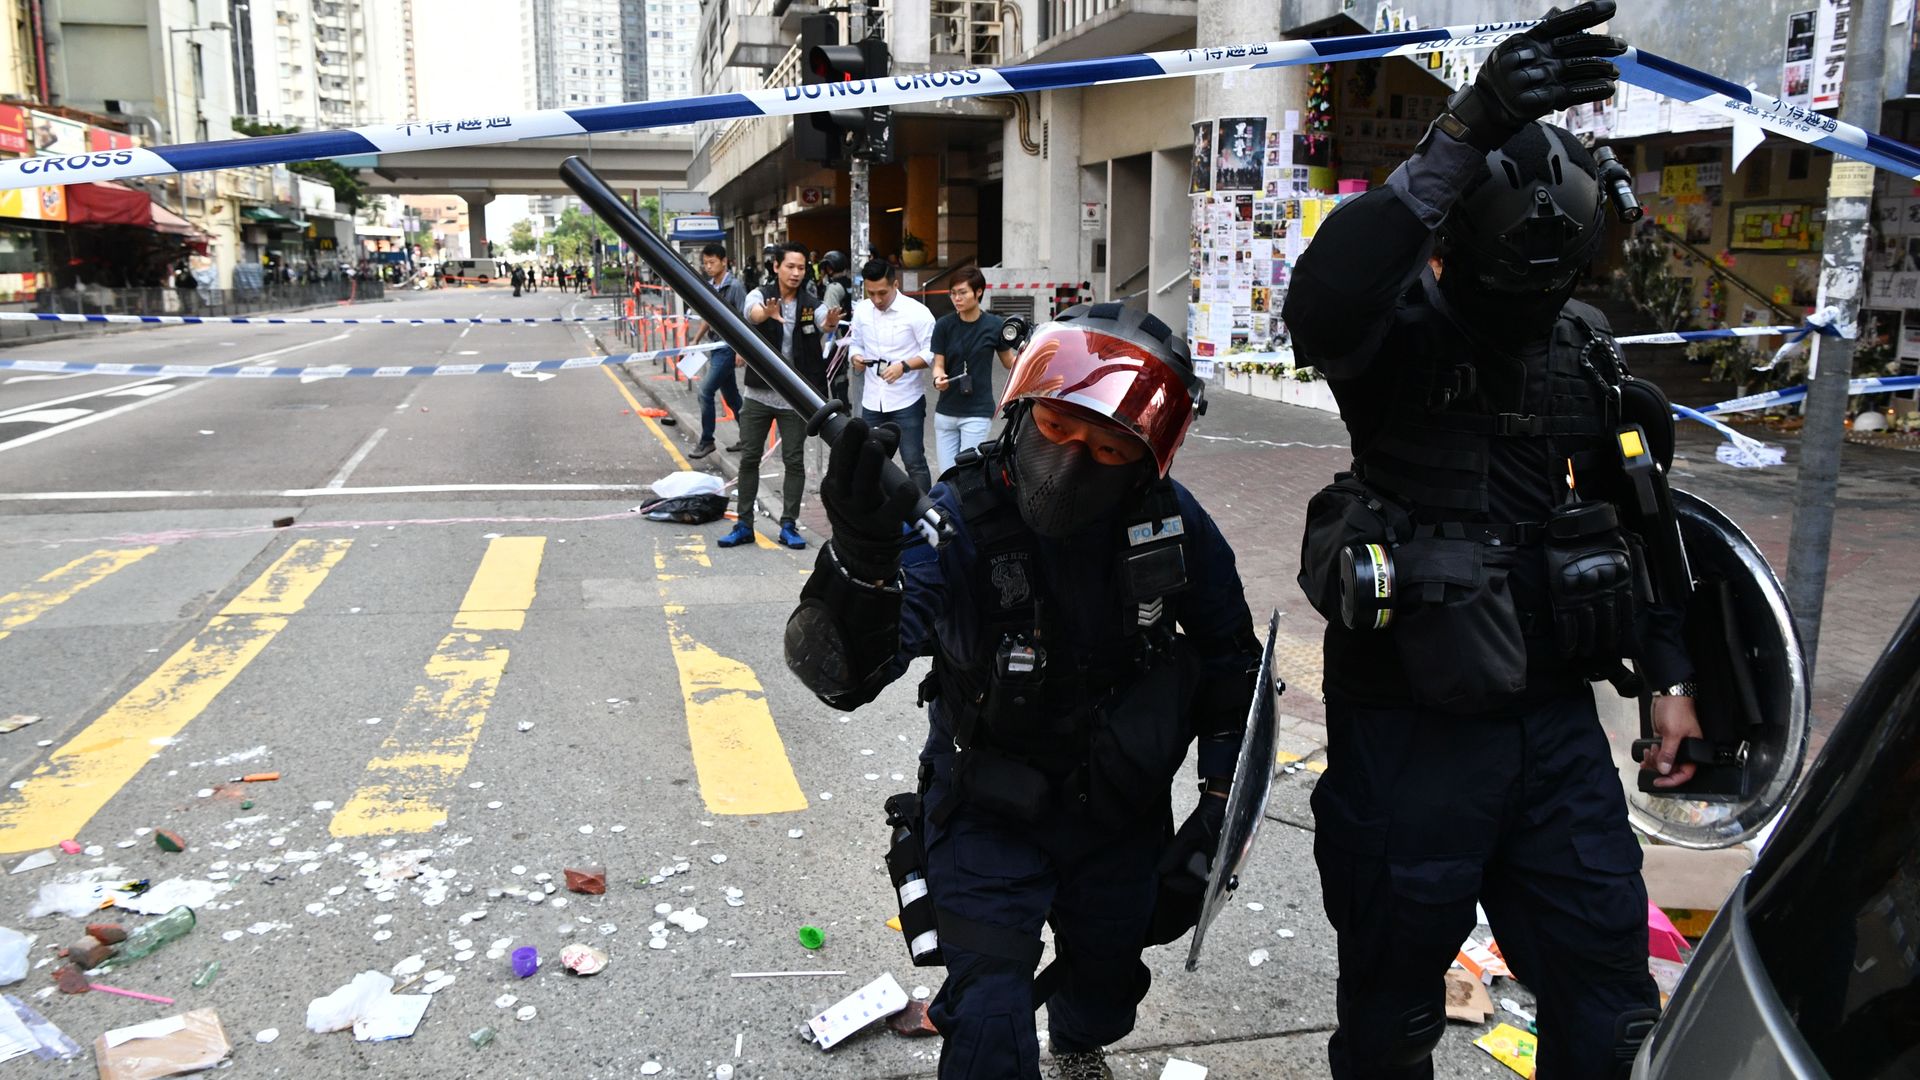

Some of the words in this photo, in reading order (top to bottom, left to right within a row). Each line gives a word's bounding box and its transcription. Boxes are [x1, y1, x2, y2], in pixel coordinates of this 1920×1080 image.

[784, 86, 821, 101] DO
[894, 69, 981, 91] CROSS
[20, 151, 132, 174] CROSS
